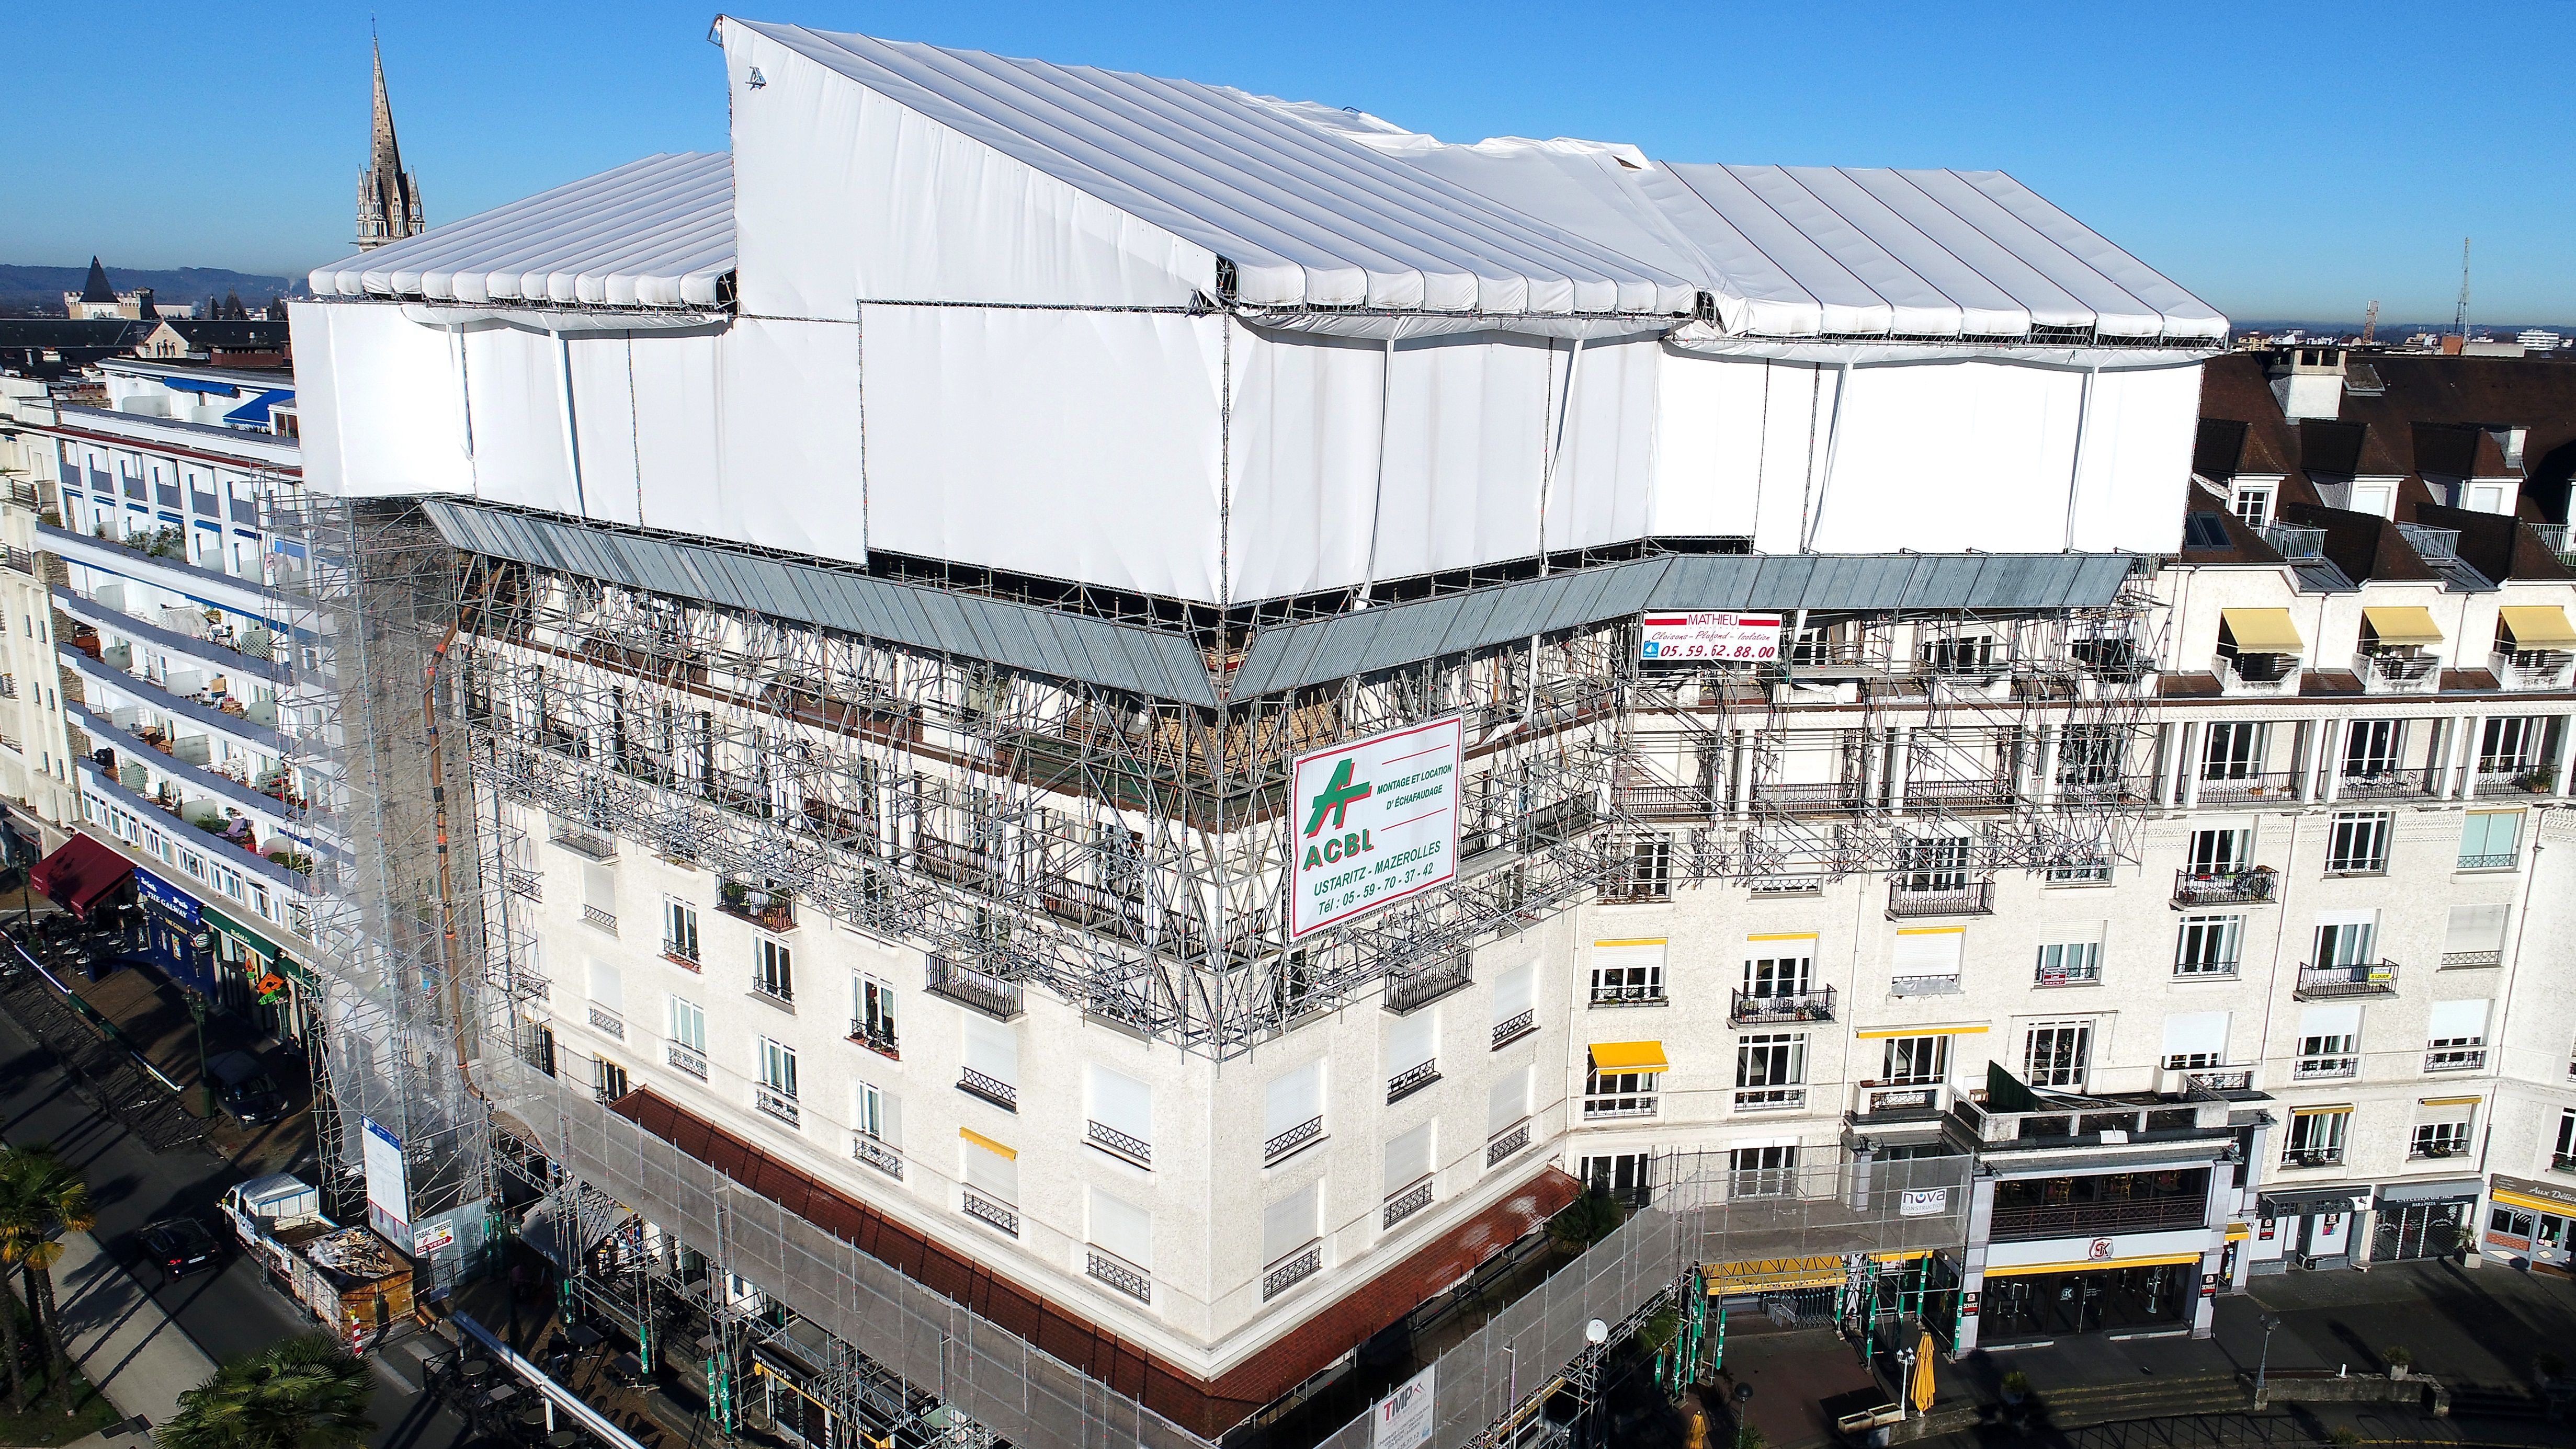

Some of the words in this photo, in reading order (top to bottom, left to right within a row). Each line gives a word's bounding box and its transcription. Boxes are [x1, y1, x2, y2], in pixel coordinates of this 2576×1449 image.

[1688, 614, 1738, 625] MATHIEU
[1652, 632, 1688, 640] Cloisons
[1695, 631, 1730, 642] Plafond
[1738, 632, 1771, 641] Isolation
[1660, 645, 1775, 658] 05.59.62.88.00
[1377, 777, 1411, 795] MONTAGE
[1411, 774, 1420, 784] ET
[1421, 763, 1452, 781] LOCATION
[1394, 784, 1443, 807] ÉCHAFAUDAGE
[1302, 828, 1374, 872] ACBL
[1314, 866, 1367, 896] USTARITZ
[1374, 840, 1441, 875] MAZEROLLES
[1319, 901, 1334, 916] Tél
[1343, 891, 1355, 906] 05
[1363, 883, 1375, 898] 59
[1384, 876, 1396, 891] 70
[1404, 869, 1415, 884] 37
[1423, 862, 1434, 876] 42
[146, 891, 160, 903] THE
[161, 899, 187, 918] GALWAY
[173, 896, 188, 909] Pub
[1903, 1190, 1945, 1204] nova
[2528, 1186, 2549, 1196] Aux
[1902, 1202, 1944, 1211] CONSTRUCTION
[416, 1229, 431, 1240] TABAC
[434, 1222, 451, 1233] PRESSE
[417, 1238, 447, 1252] OUVERT
[752, 1349, 792, 1381] brasserie
[921, 1404, 934, 1415] de
[1384, 1385, 1413, 1421] TMP
